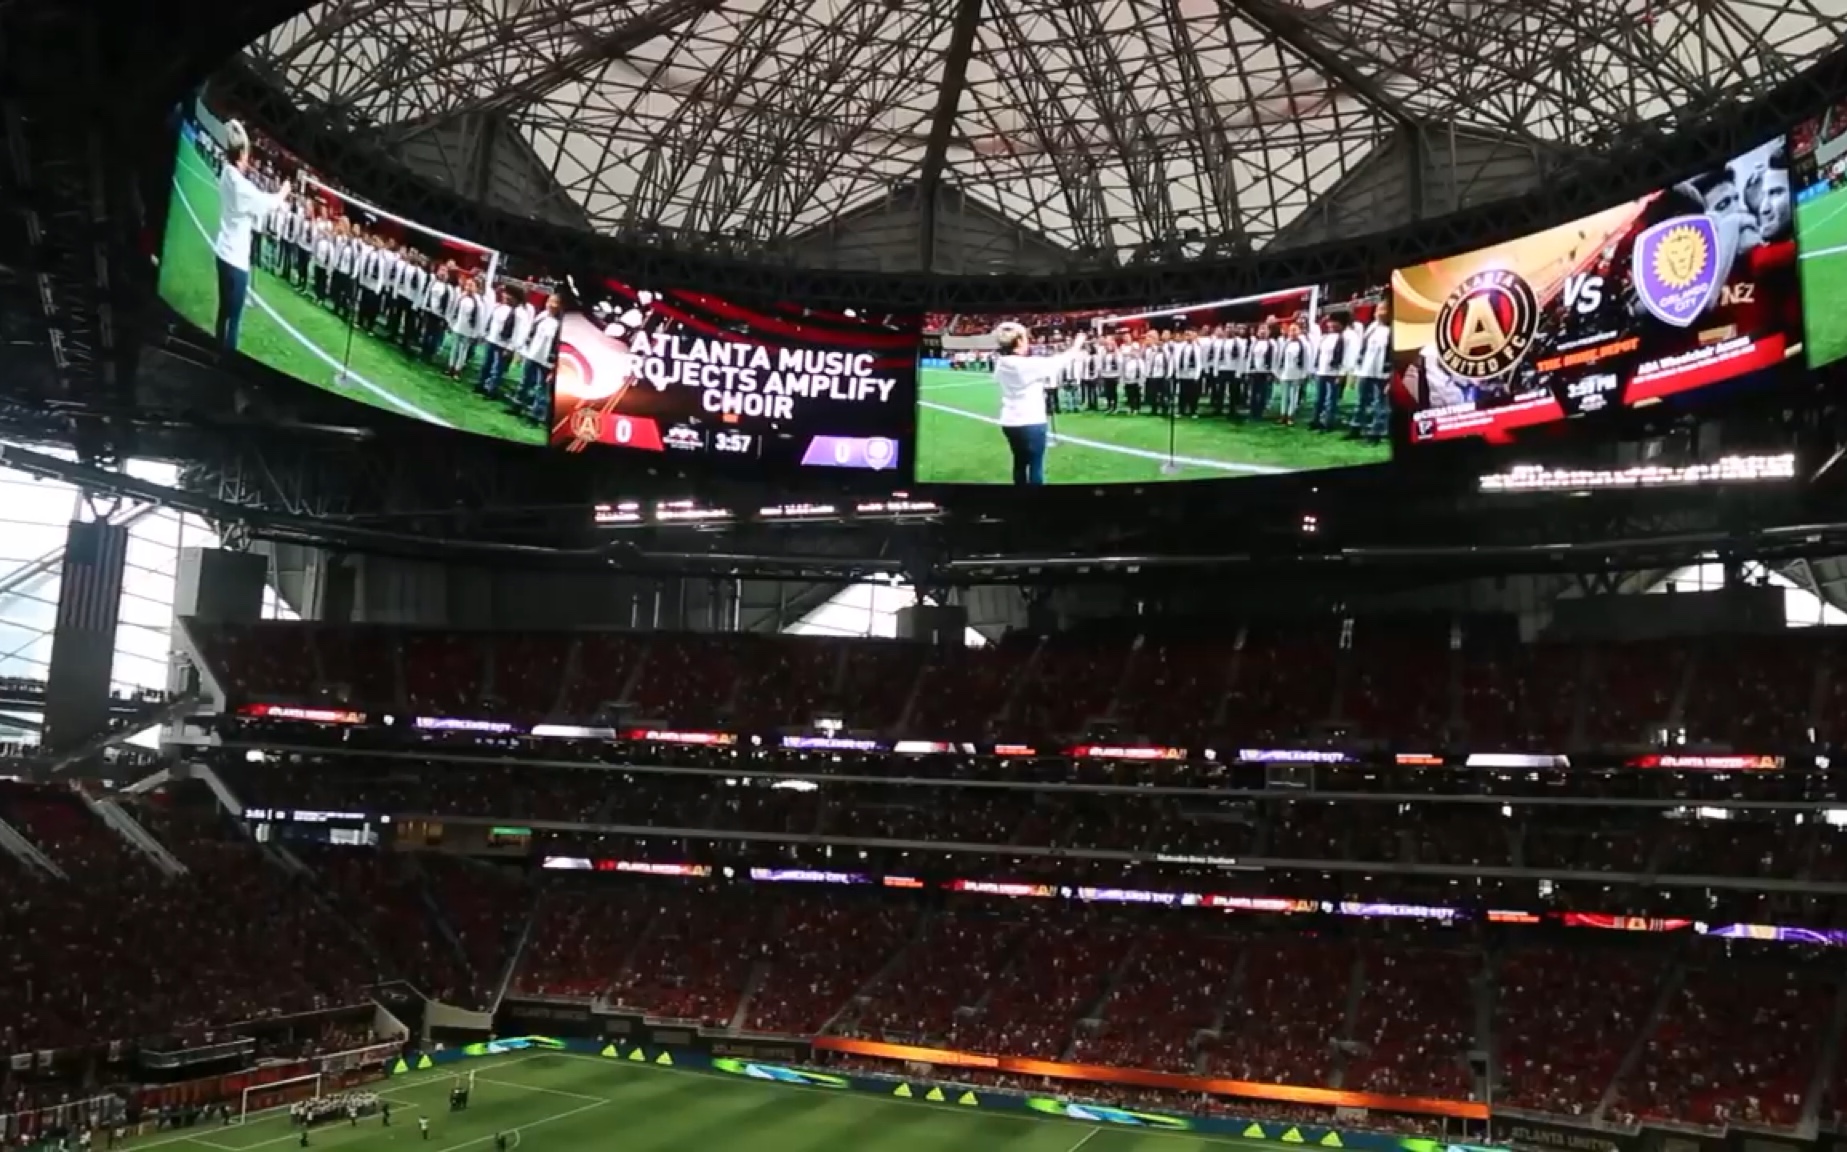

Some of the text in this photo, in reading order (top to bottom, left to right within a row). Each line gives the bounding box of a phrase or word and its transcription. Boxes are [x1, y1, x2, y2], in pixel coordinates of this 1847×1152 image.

[1563, 271, 1604, 314] VS
[629, 330, 875, 378] ATLANTA MUSIC
[1442, 347, 1500, 377] UNITED
[1501, 334, 1527, 361] FC
[628, 354, 897, 403] ROJECTS AMPLIFY
[702, 388, 794, 420] CHOIR
[615, 418, 633, 444] 0
[715, 432, 752, 453] 3:57
